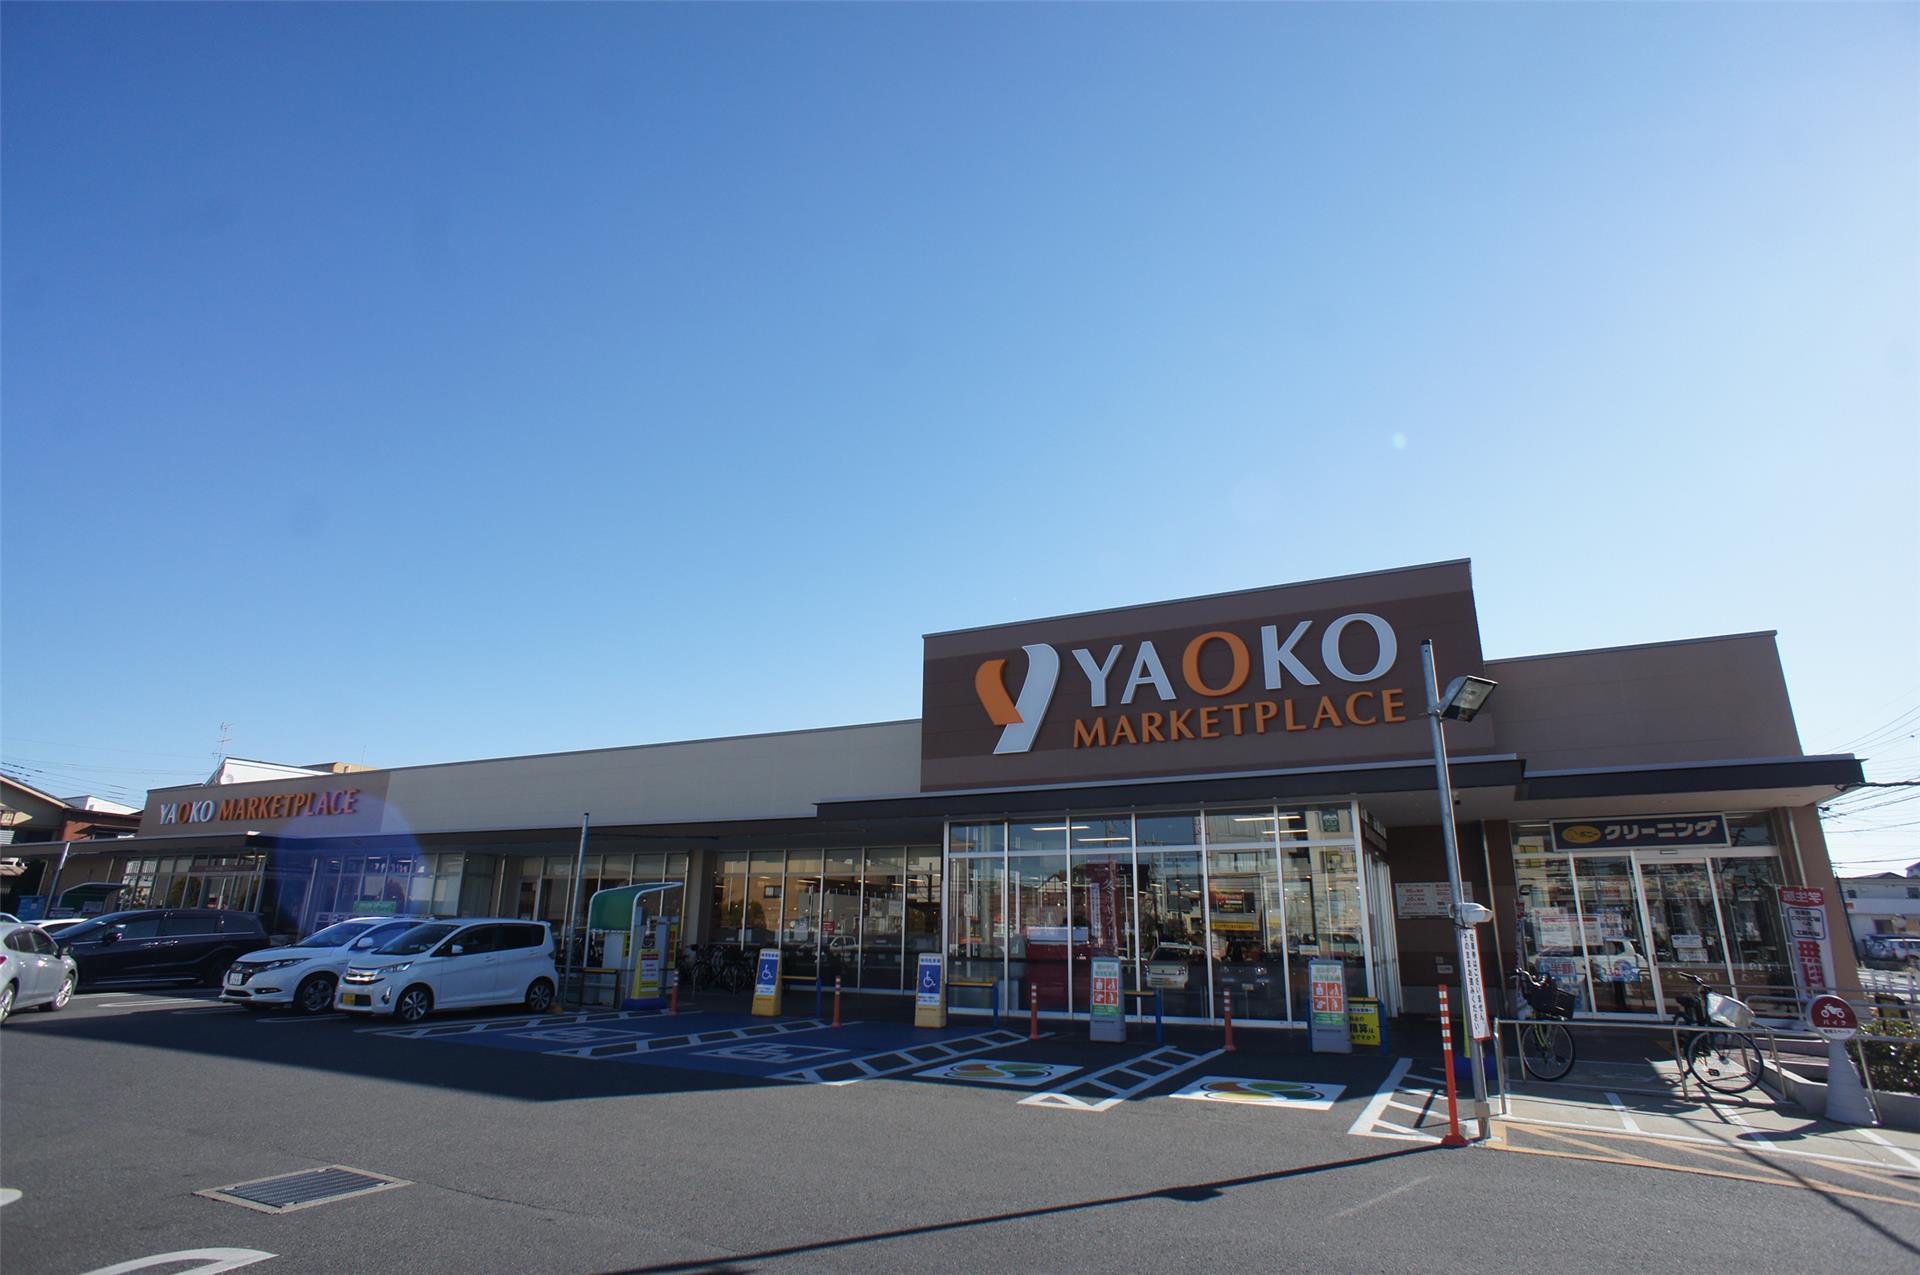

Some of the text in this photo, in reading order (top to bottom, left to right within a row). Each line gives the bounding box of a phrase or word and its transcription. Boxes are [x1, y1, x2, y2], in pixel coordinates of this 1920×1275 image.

[1071, 612, 1399, 708] YAOKO
[1073, 688, 1407, 749] MARKETPLACE
[160, 789, 361, 825] YAOKO MARKETPLACE
[1604, 819, 1718, 841] クリーニング
